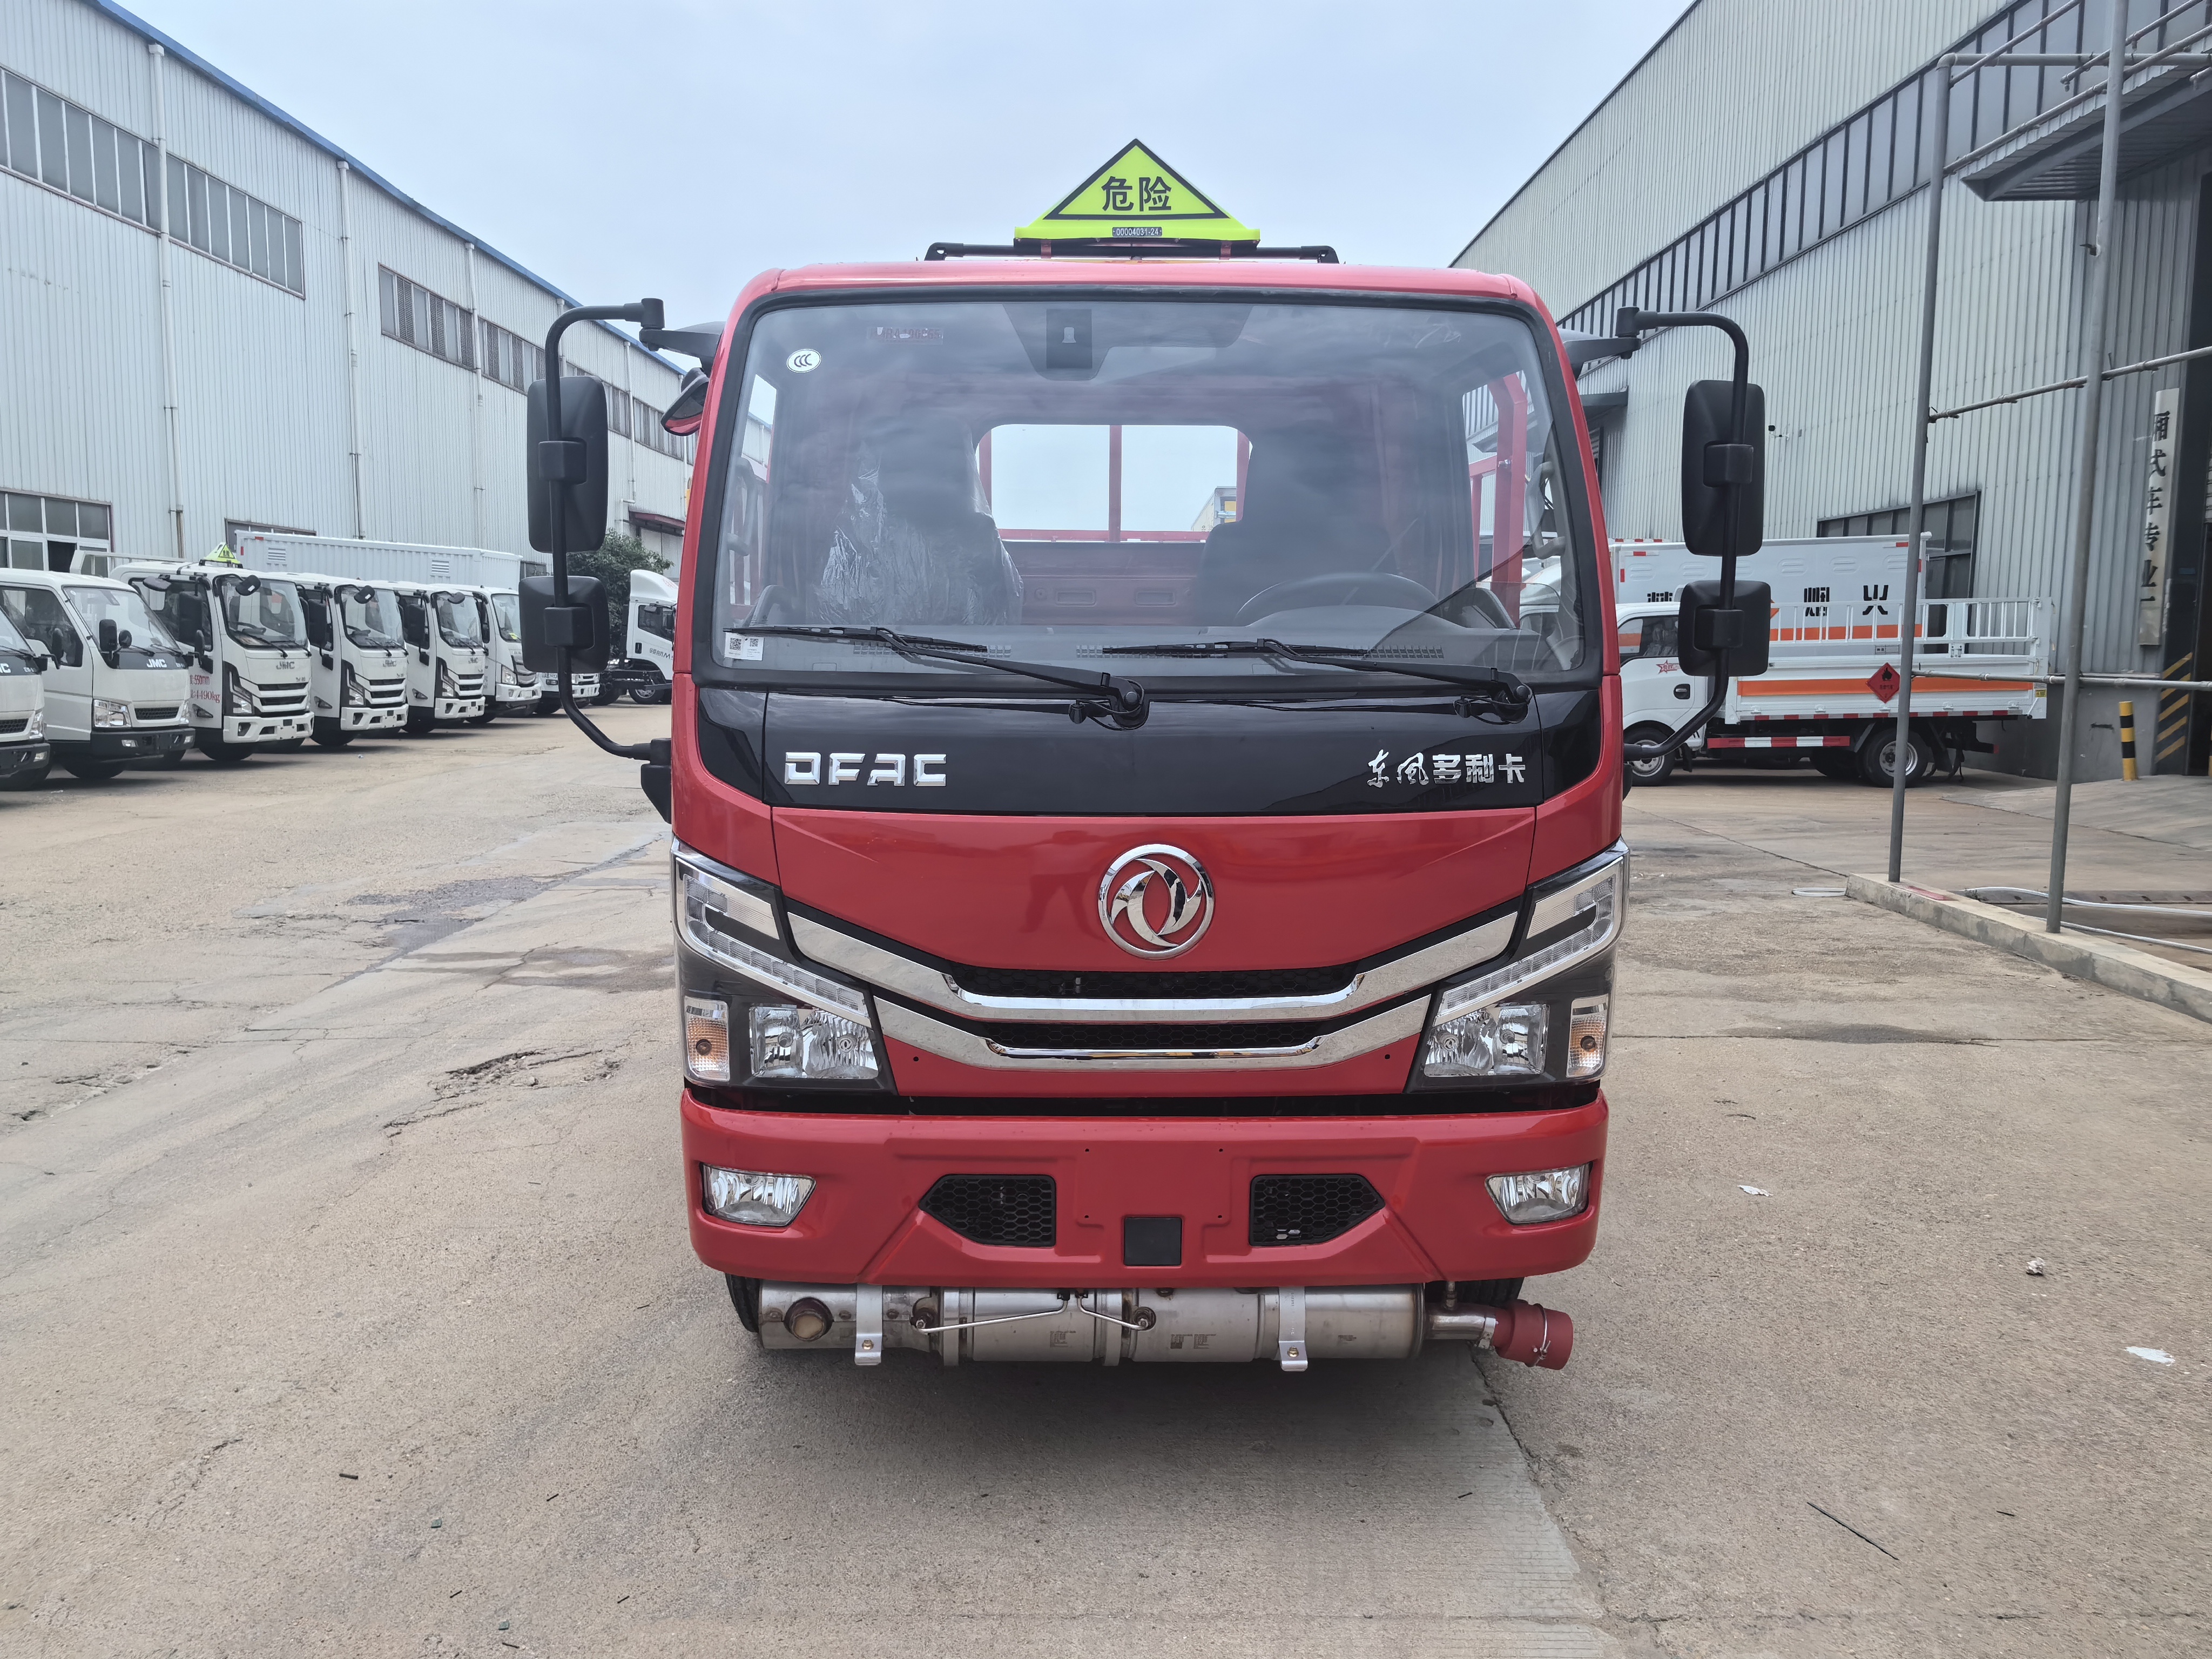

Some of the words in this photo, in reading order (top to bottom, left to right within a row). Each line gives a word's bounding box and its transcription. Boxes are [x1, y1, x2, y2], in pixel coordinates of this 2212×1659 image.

[1101, 176, 1172, 212] 危险
[1116, 228, 1158, 236] 00004031-24
[794, 353, 812, 367] CCC
[2140, 410, 2170, 601] 厢式车专业
[146, 659, 167, 668] JMC
[785, 752, 947, 787] DFAC
[1367, 749, 1526, 788] 东风多利卡
